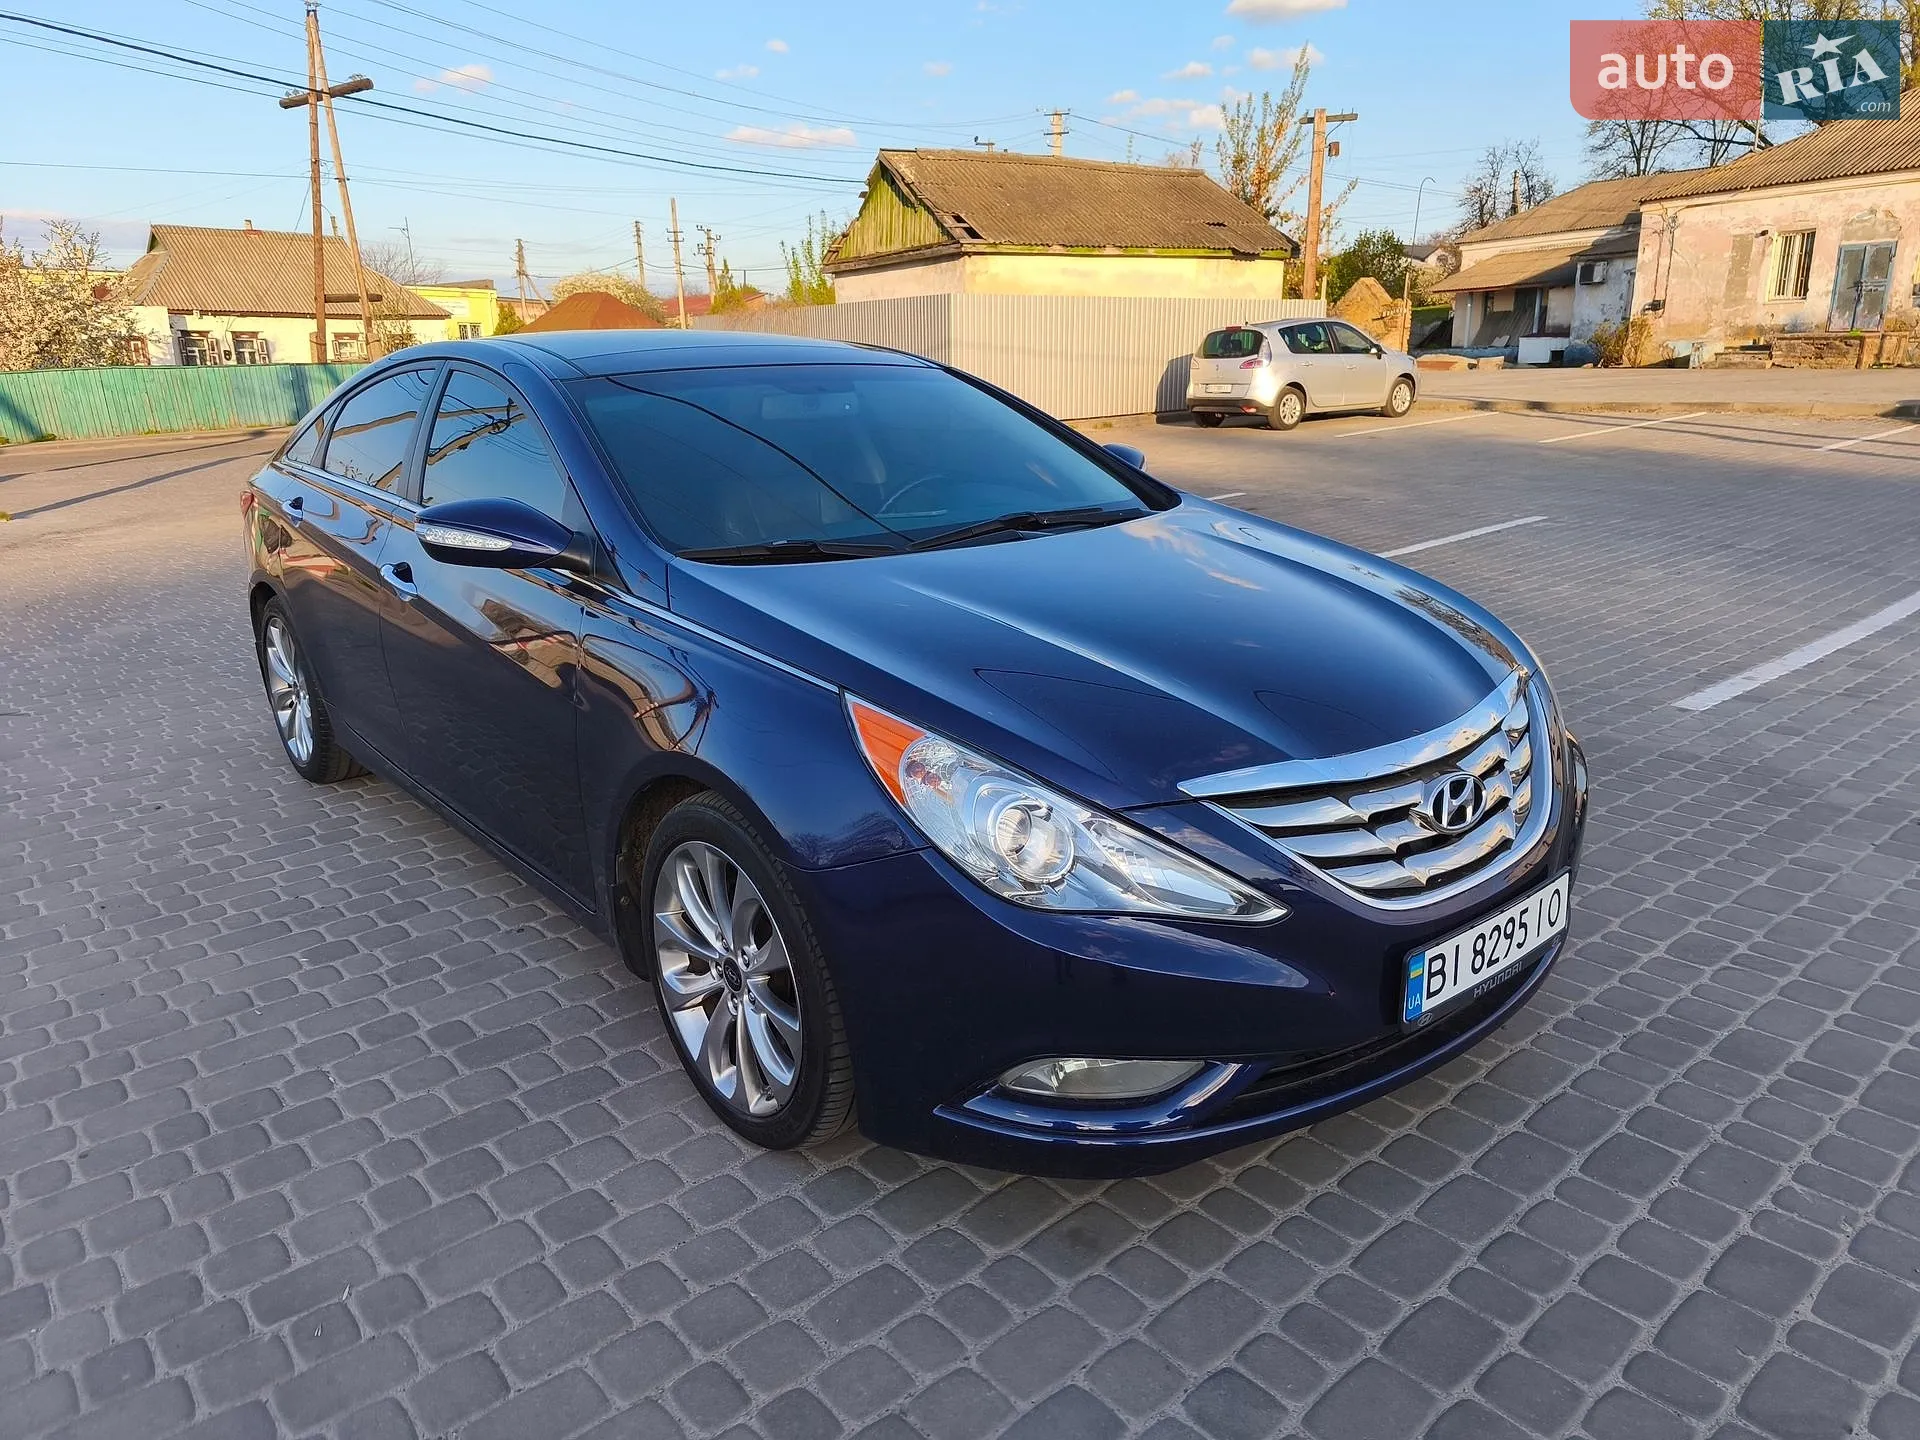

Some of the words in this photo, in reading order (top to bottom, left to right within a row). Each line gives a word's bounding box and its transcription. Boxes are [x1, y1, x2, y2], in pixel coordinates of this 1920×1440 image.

[1426, 944, 1460, 1000] BI
[1471, 908, 1529, 975] 8295
[1536, 888, 1561, 938] IO
[1408, 993, 1421, 1010] UA
